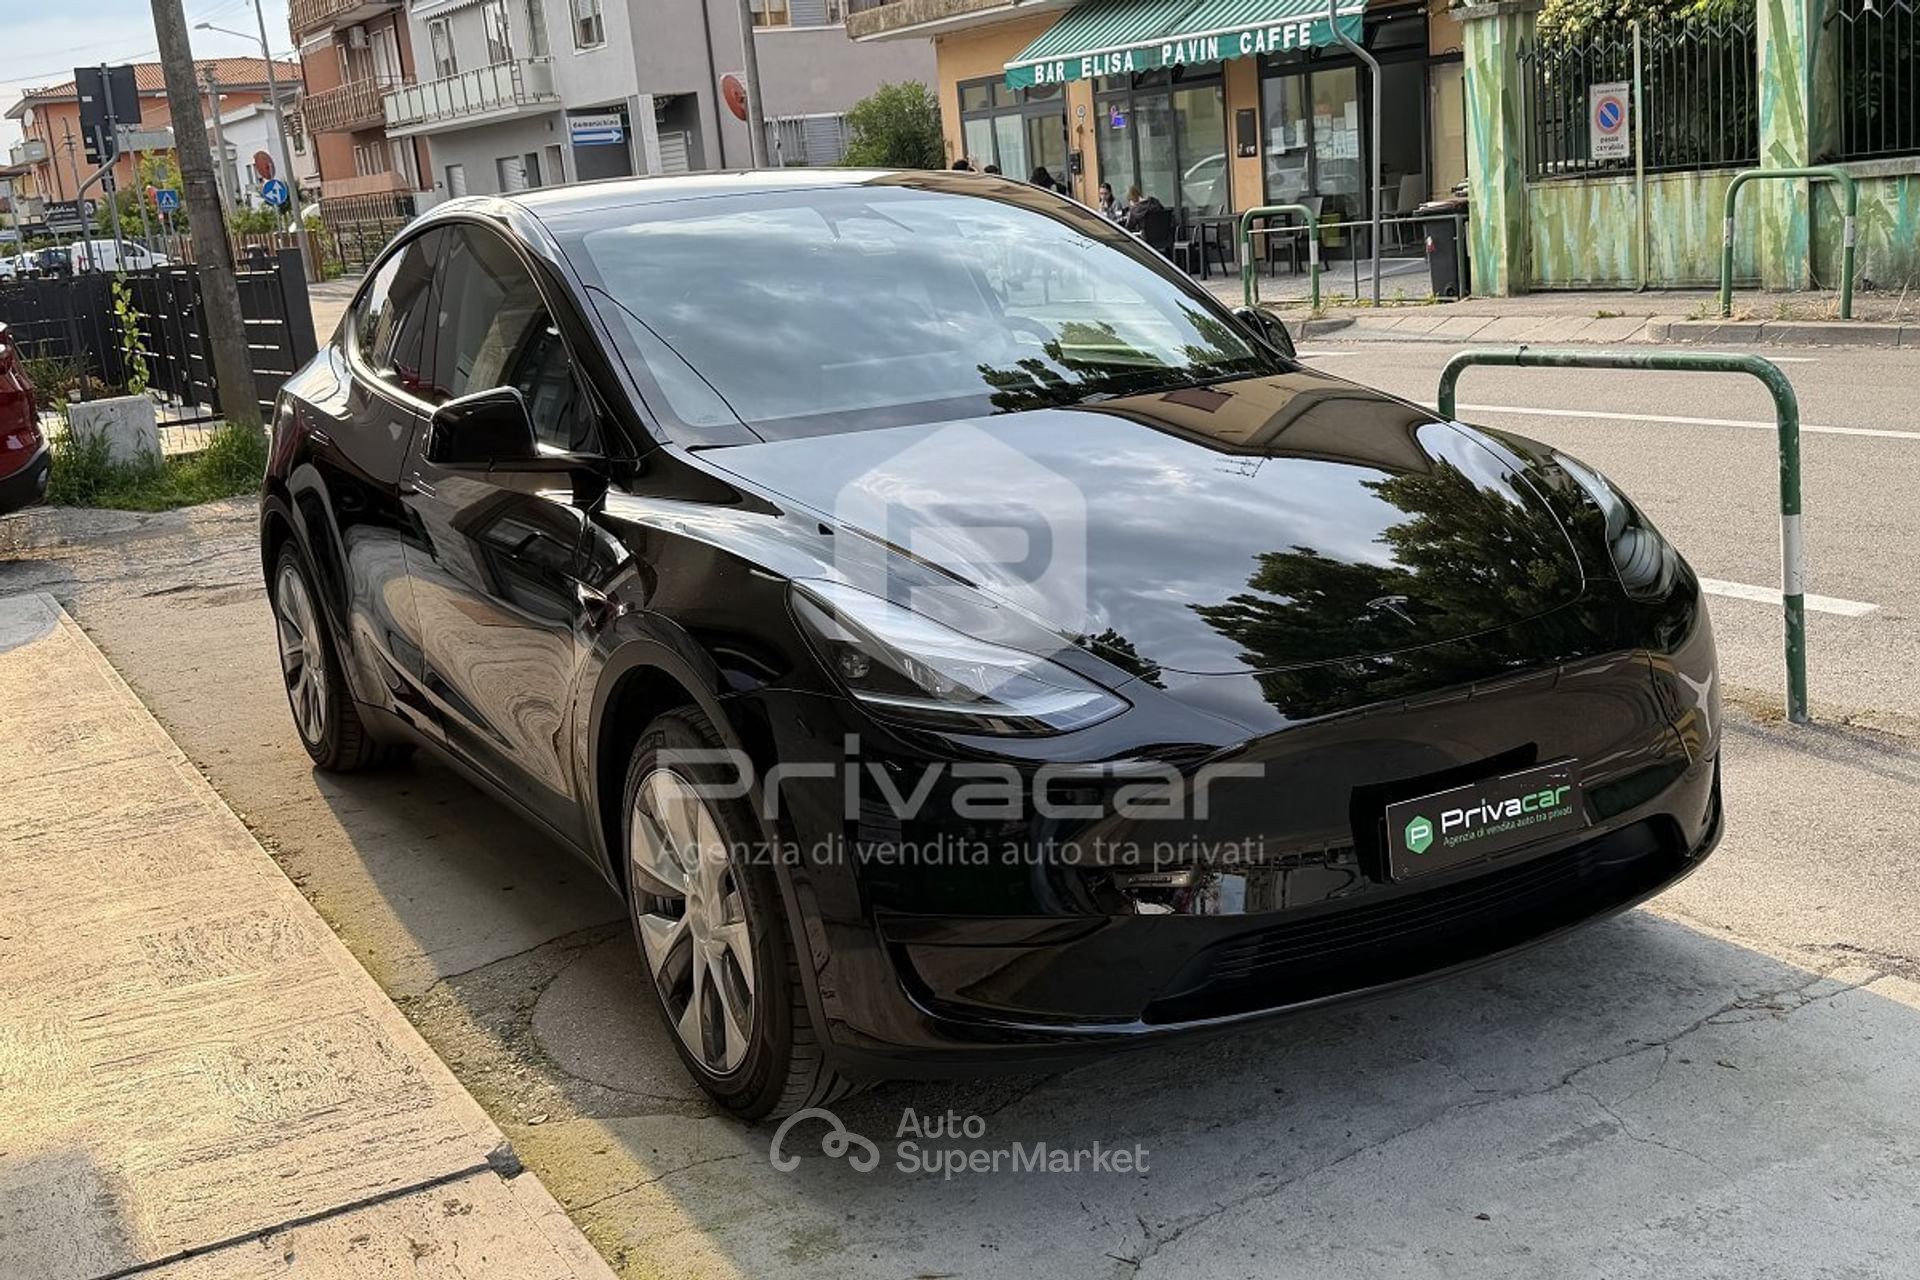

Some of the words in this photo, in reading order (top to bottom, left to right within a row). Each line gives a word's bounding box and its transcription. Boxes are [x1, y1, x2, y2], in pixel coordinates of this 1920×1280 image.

[1034, 61, 1065, 84] BAR
[1081, 50, 1134, 78] ELISA
[1162, 36, 1218, 65] PAVIN
[1441, 785, 1571, 834] Privacar
[1443, 829, 1476, 847] Agenzia
[1476, 825, 1485, 838] di
[1486, 818, 1516, 835] vendita
[1516, 814, 1535, 827] auto
[1535, 811, 1547, 822] tra
[1548, 803, 1573, 822] privati
